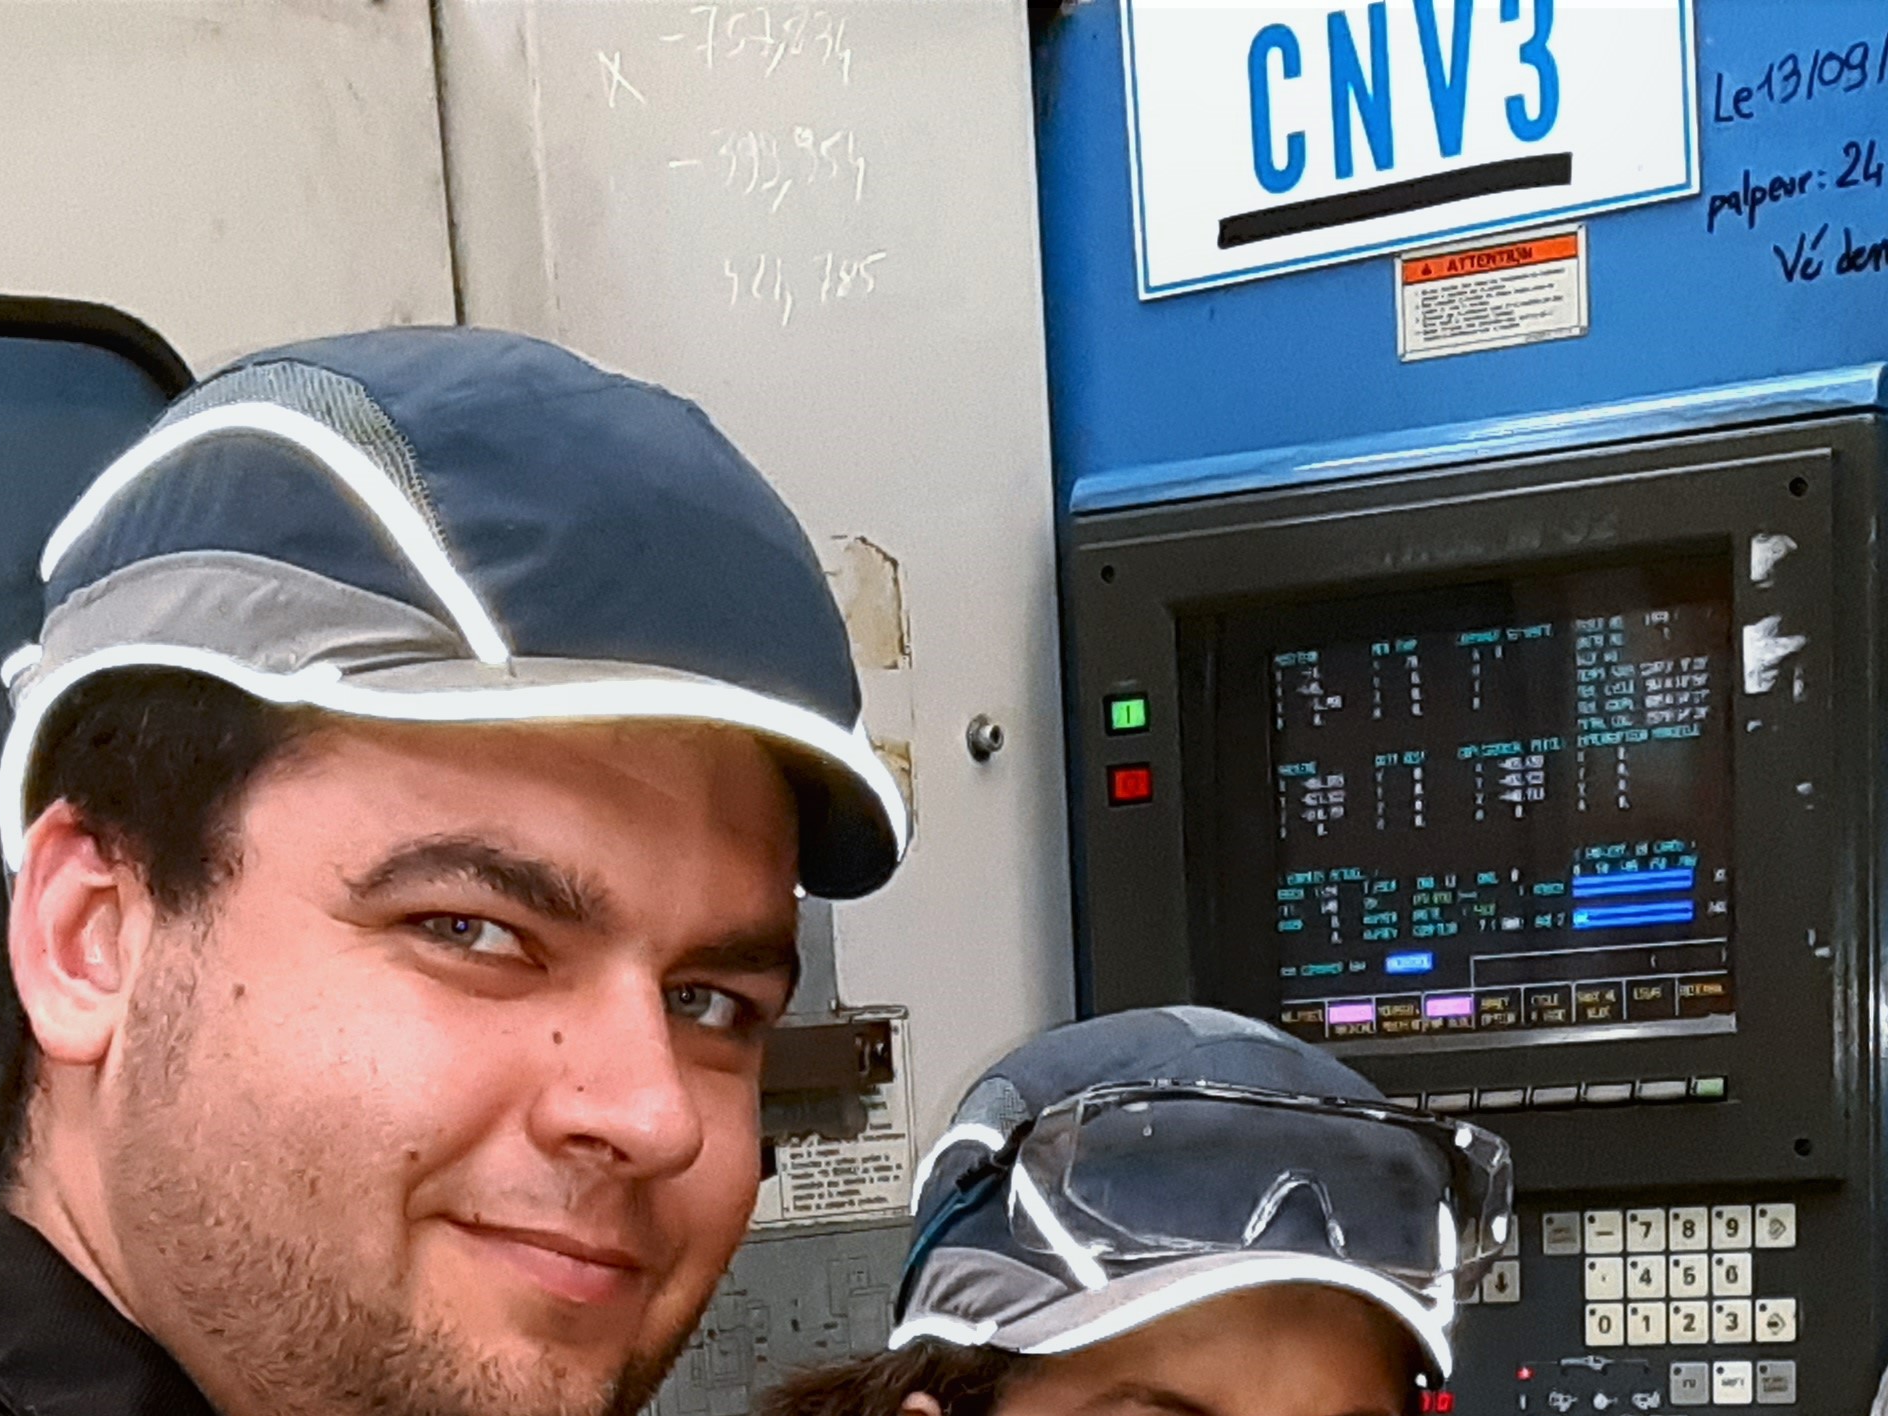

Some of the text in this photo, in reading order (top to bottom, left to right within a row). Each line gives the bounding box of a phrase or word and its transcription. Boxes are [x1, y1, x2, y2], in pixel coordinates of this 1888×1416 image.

[1248, 0, 1560, 194] CNV3
[1714, 72, 1754, 122] Le
[1446, 246, 1533, 273] ATTENTION
[1638, 1217, 1739, 1239] 7 8 9
[1638, 1267, 1652, 1286] 4
[1597, 1314, 1612, 1335] 0
[1682, 1312, 1697, 1333] 2
[1725, 1311, 1739, 1332] 3
